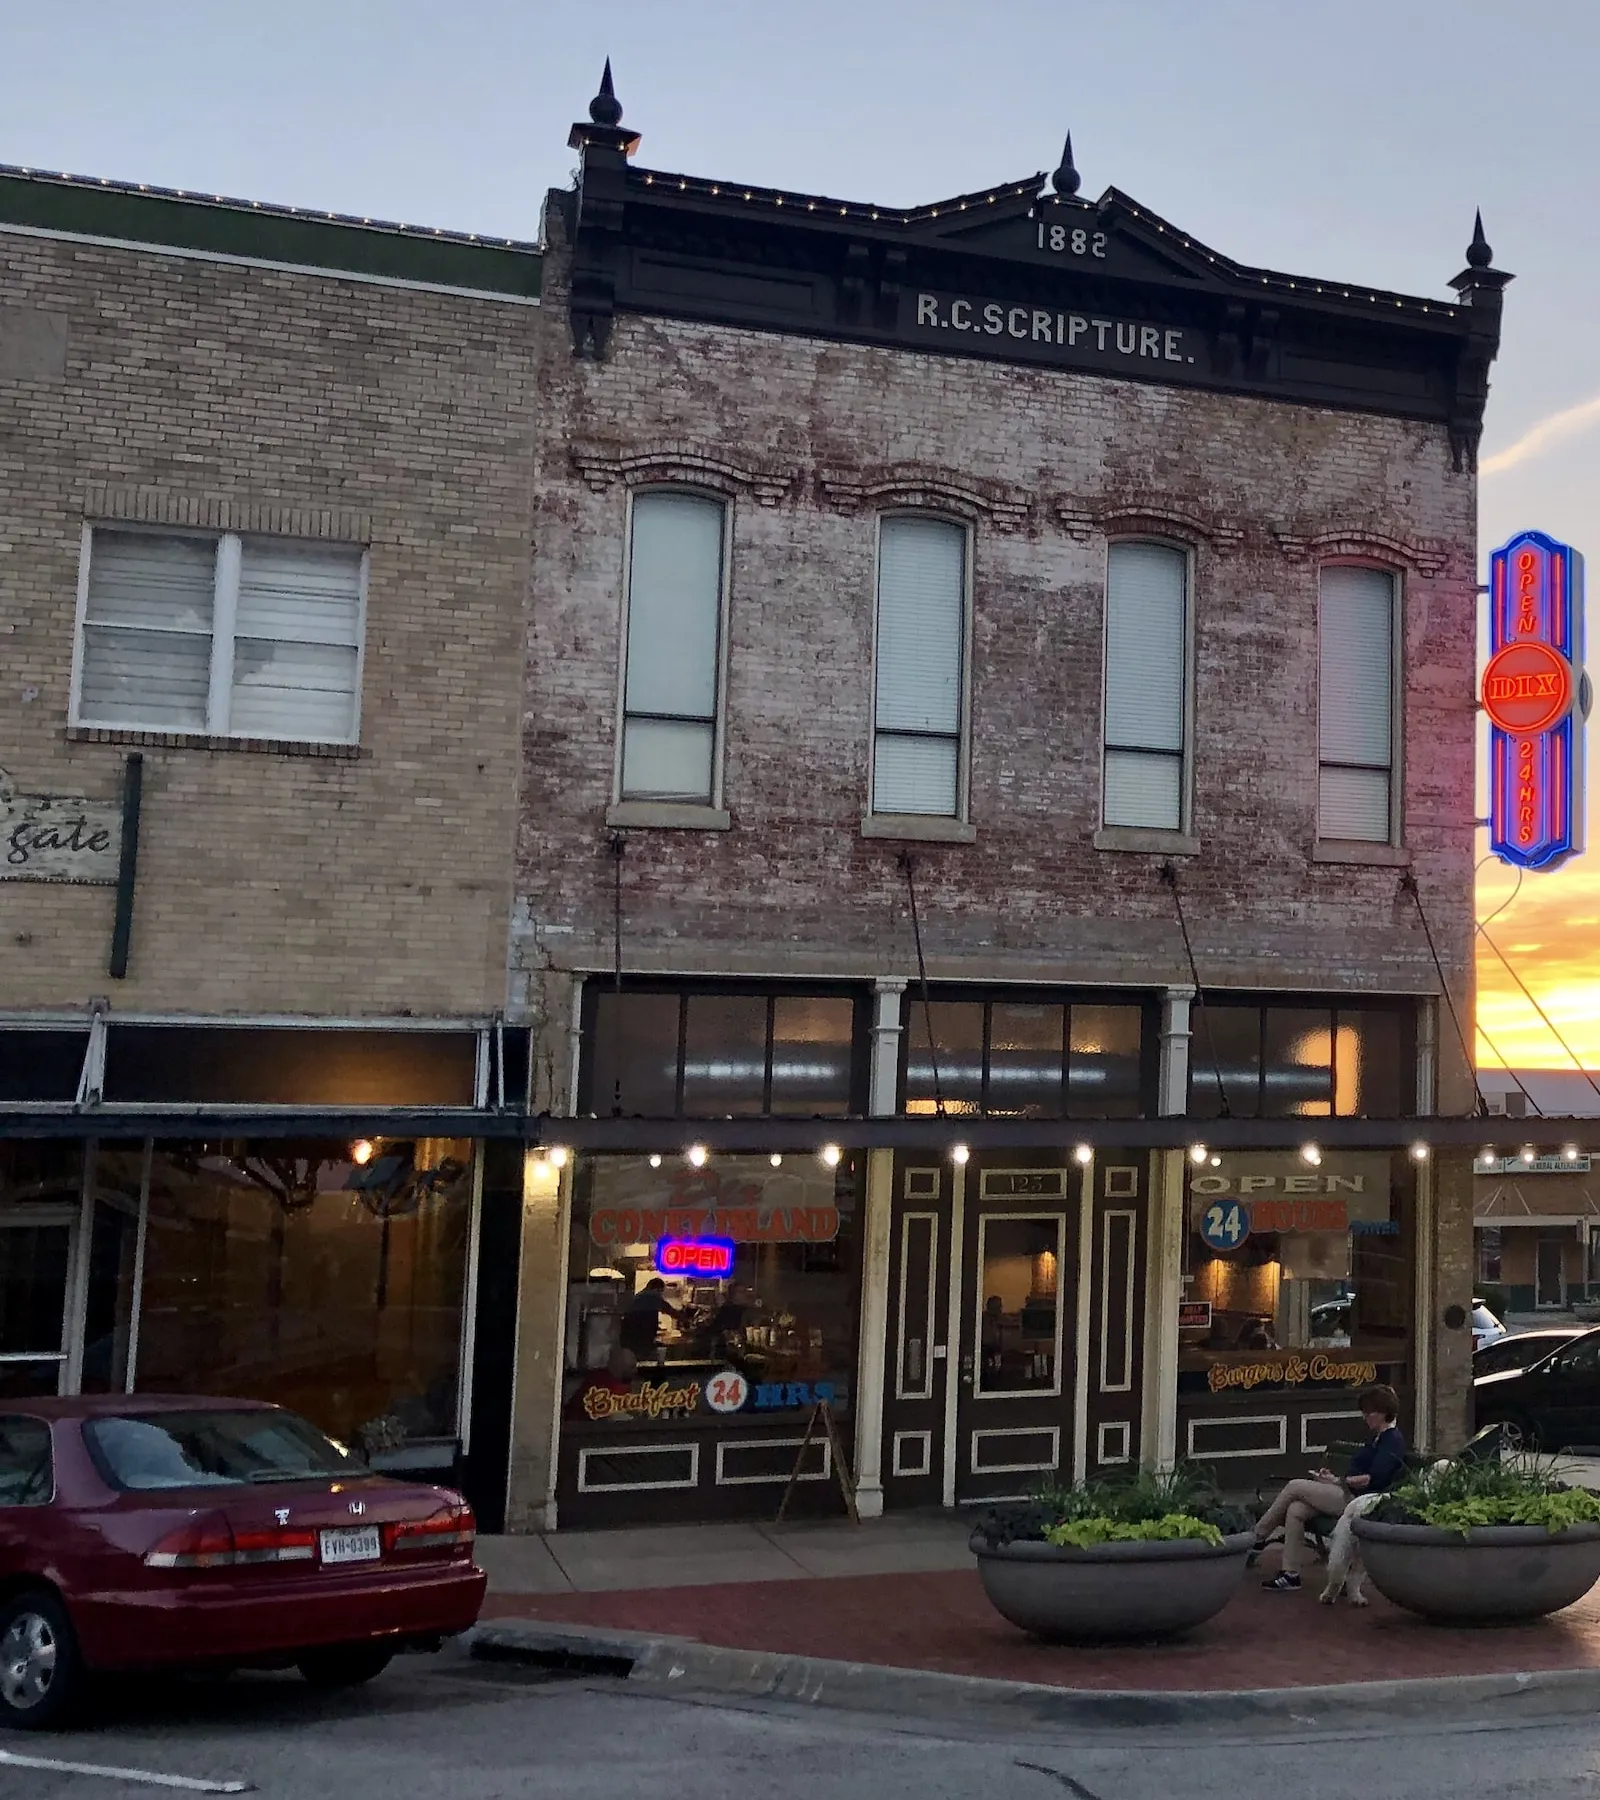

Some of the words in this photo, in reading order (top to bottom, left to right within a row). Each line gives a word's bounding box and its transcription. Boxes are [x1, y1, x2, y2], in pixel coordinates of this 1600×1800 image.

[1037, 222, 1108, 258] 1882
[1518, 552, 1534, 632] OPEN
[1489, 673, 1558, 700] DIX
[1189, 1175, 1365, 1194] OPEN
[714, 1206, 839, 1241] ISLAND
[1206, 1205, 1242, 1243] 24
[664, 1245, 729, 1269] OPEN
[1208, 1363, 1284, 1393] Burgers
[1285, 1355, 1308, 1382] &
[1309, 1354, 1376, 1387] Coneys
[584, 1382, 701, 1420] Breakfast
[712, 1379, 741, 1406] 24
[754, 1382, 836, 1407] HRS
